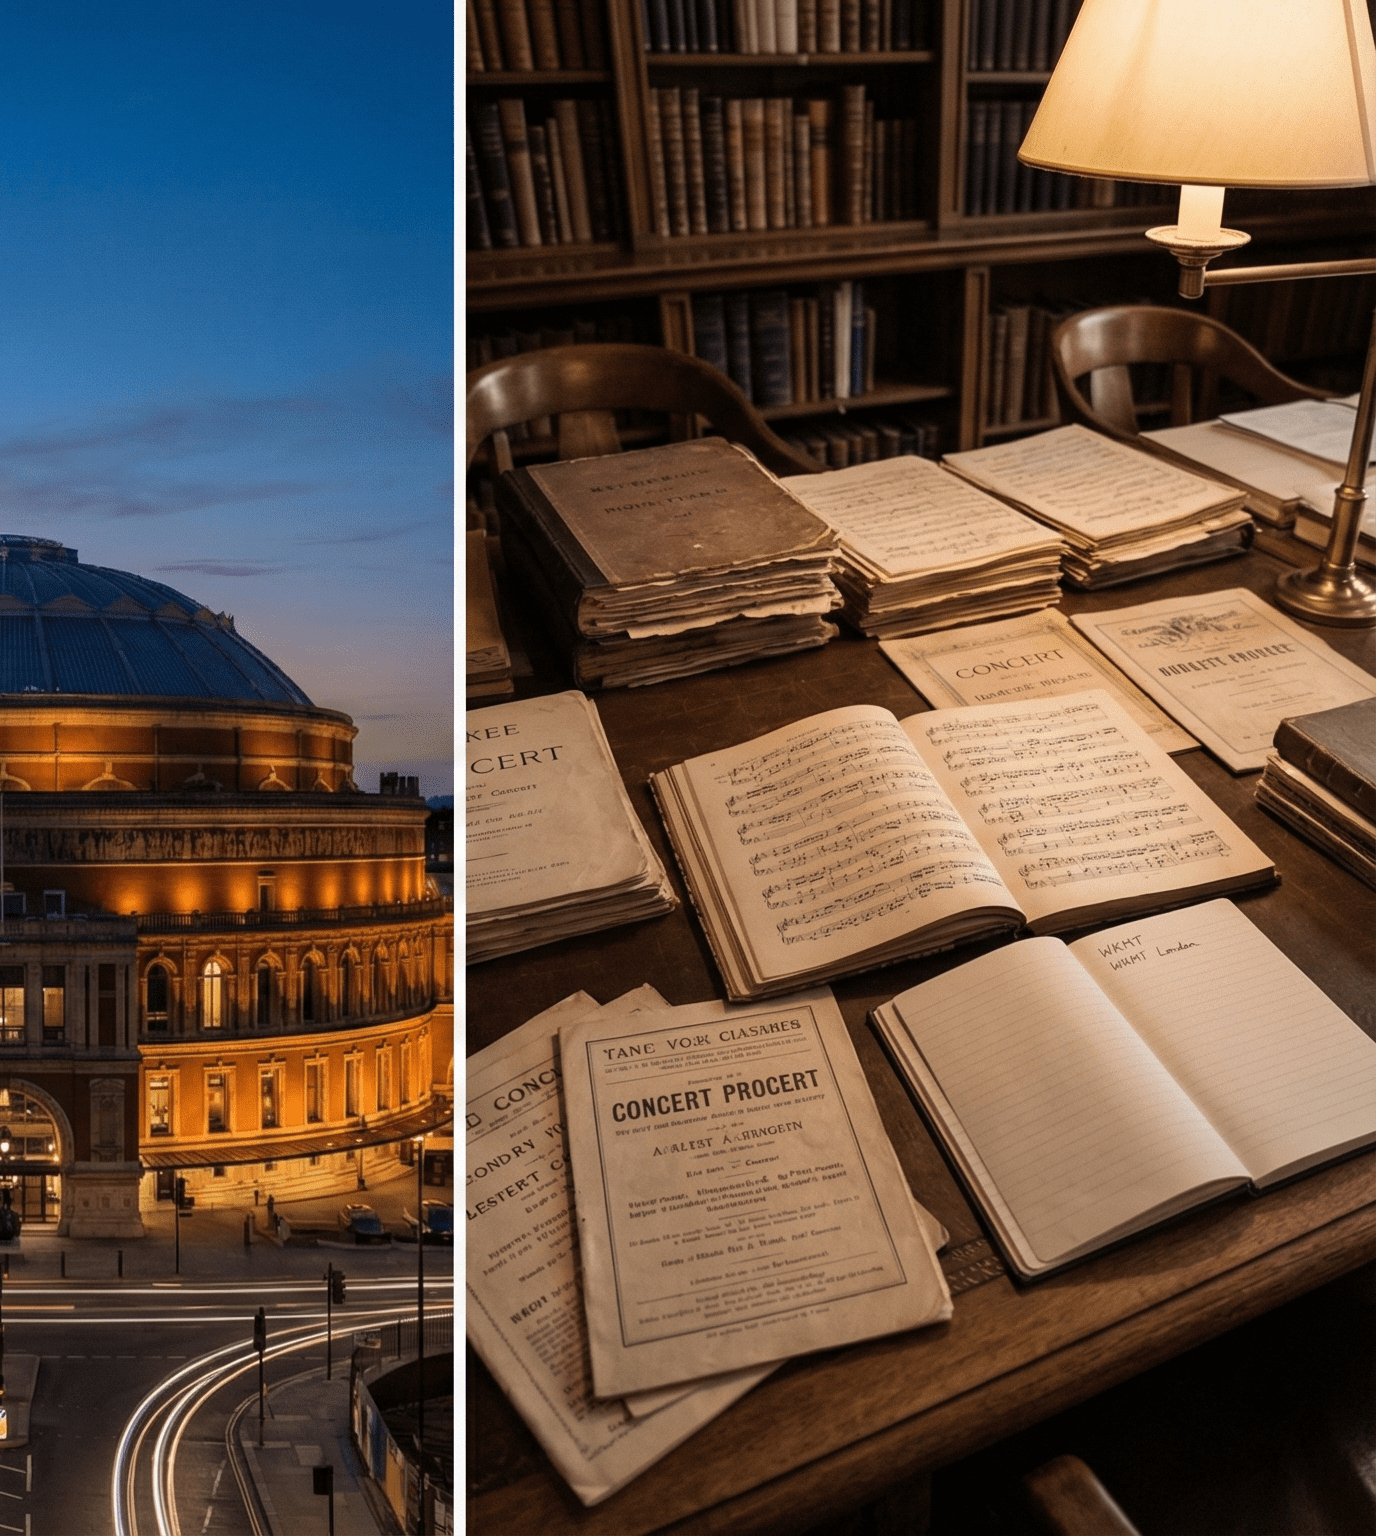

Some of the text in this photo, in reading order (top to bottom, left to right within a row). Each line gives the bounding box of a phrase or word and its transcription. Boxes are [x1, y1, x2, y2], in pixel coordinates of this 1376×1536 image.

[956, 649, 1065, 679] CONCERT
[612, 1088, 712, 1123] CONCERT
[722, 1069, 819, 1103] PROCERT
